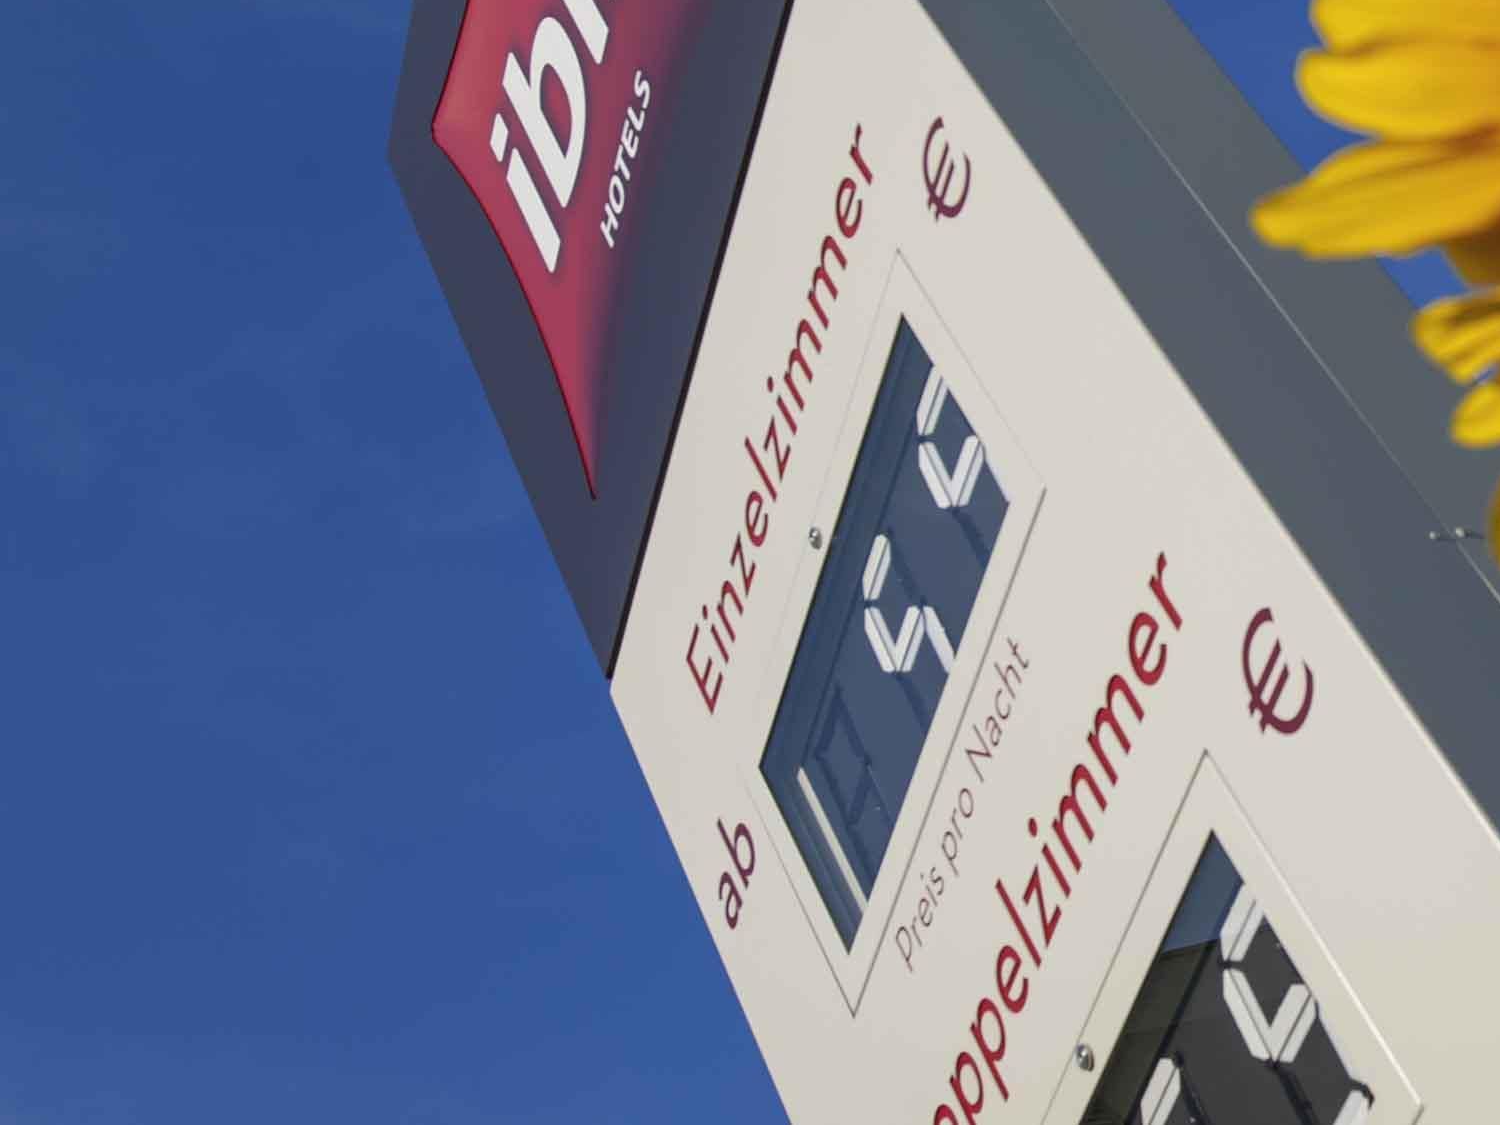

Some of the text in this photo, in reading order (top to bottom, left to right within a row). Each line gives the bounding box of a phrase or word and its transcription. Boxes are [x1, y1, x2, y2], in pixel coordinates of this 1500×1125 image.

[600, 70, 651, 248] HOTELS
[687, 123, 875, 713] Einzelzimmer
[717, 819, 756, 930] ab
[923, 115, 971, 221] €
[895, 636, 1029, 972] Preis pro Nacht
[1241, 606, 1314, 736] €
